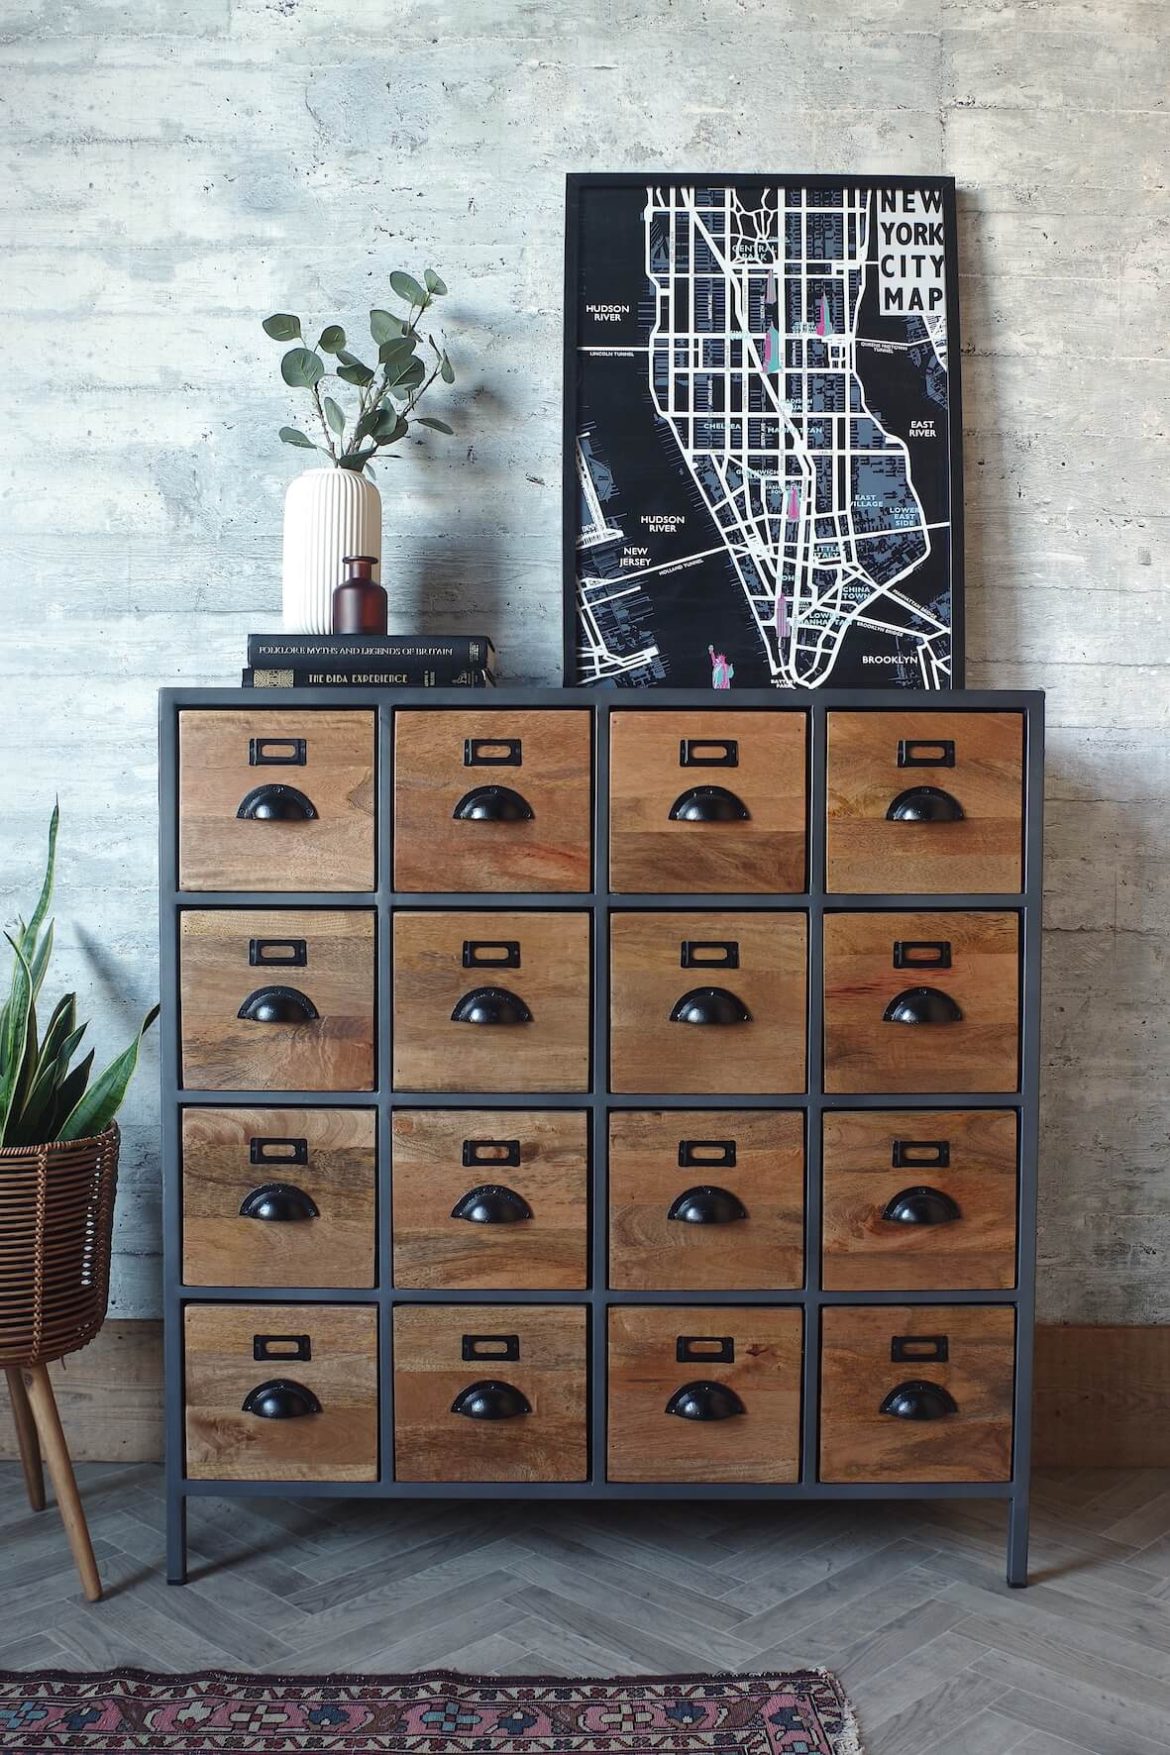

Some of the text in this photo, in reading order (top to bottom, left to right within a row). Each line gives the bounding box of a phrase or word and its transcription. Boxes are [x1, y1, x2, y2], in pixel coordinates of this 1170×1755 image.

[880, 189, 943, 213] NEW
[880, 222, 944, 246] YORK
[881, 254, 944, 278] CITY
[884, 287, 943, 311] MAP
[586, 305, 630, 313] HUDSON
[594, 313, 621, 321] RIVER
[910, 420, 935, 429] EAST
[909, 429, 937, 438] RIVER
[640, 515, 685, 524] HUDSON
[649, 524, 677, 533] RIVER
[623, 547, 648, 555] NEW
[619, 557, 652, 567] JERSEY
[259, 646, 306, 655] FOLKLORE
[306, 646, 338, 655] MYTHS
[339, 647, 360, 655] AND
[361, 647, 400, 655] LEGENDS
[862, 655, 918, 664] BROOKLYN
[308, 674, 324, 683] THE
[351, 674, 408, 683] EXPERIENCE
